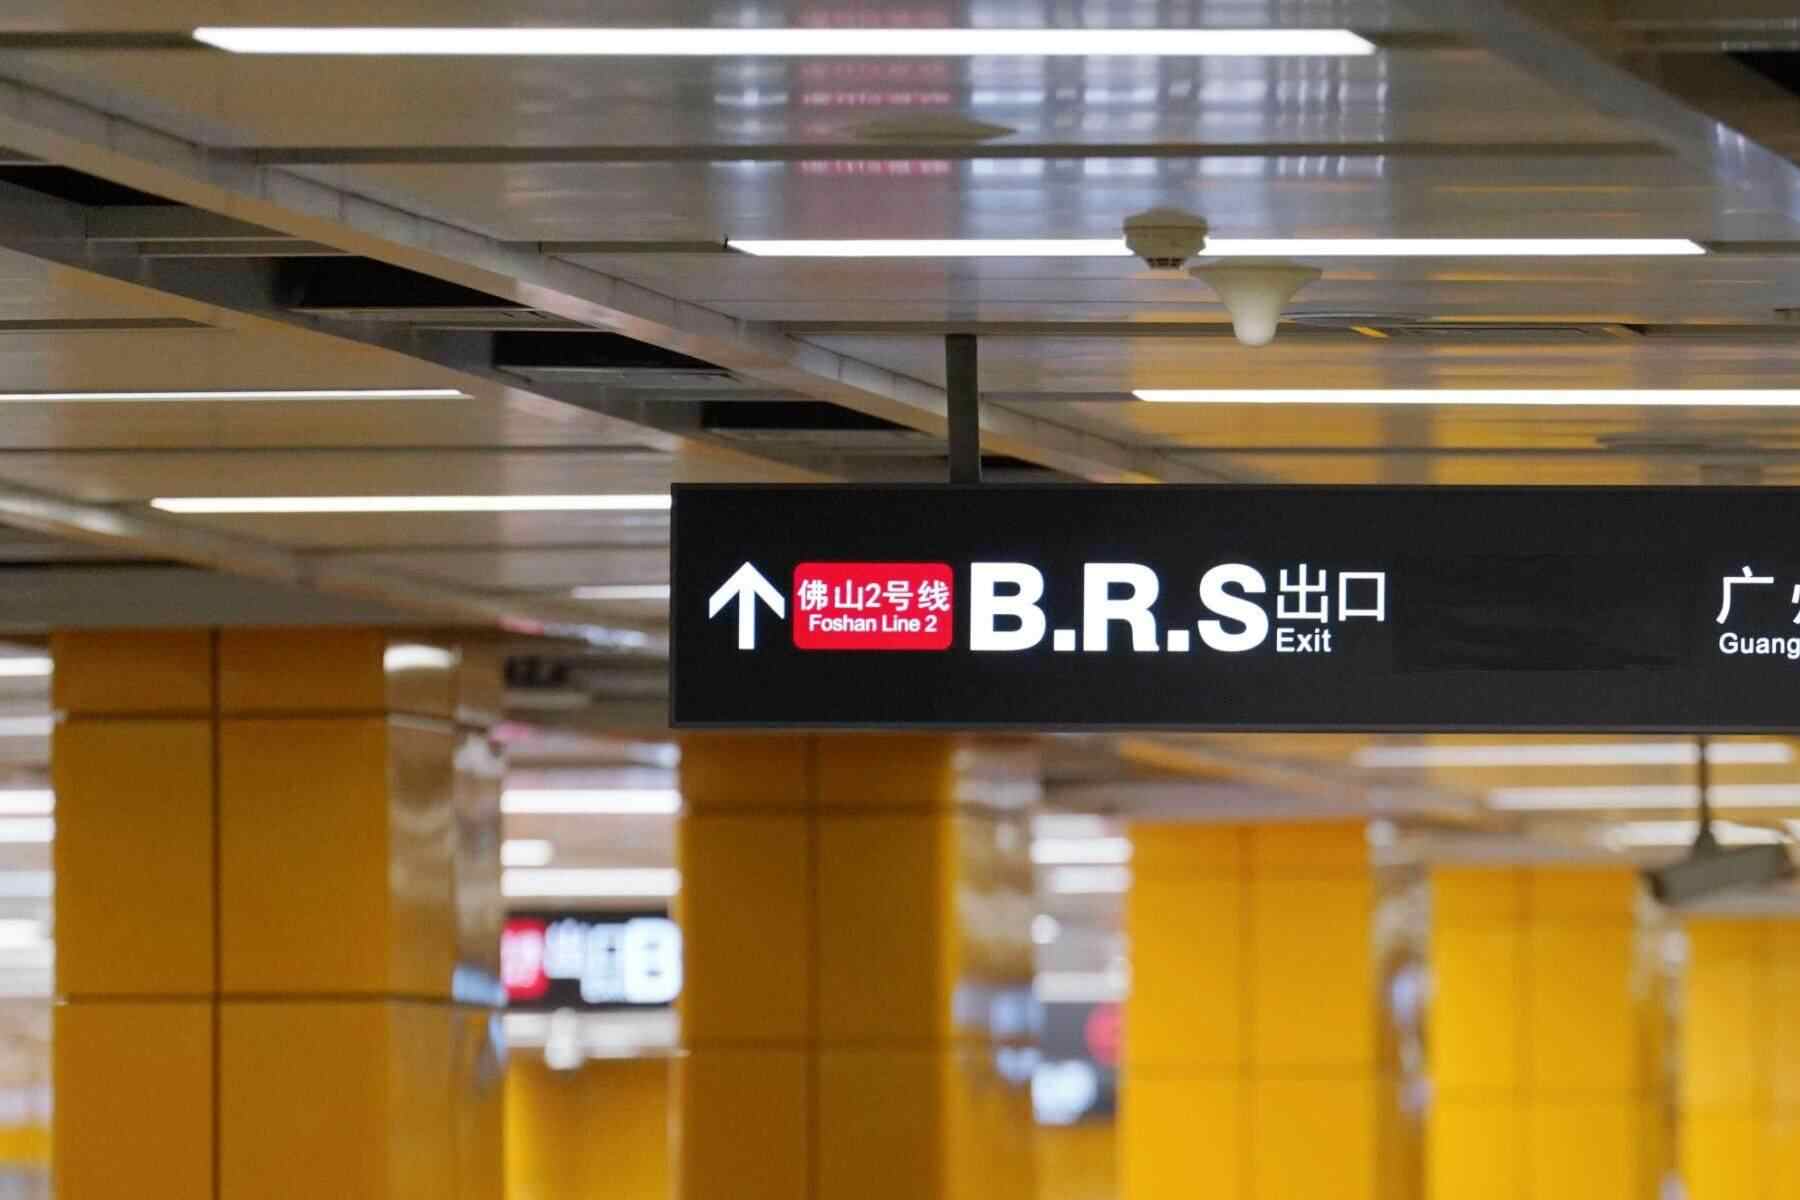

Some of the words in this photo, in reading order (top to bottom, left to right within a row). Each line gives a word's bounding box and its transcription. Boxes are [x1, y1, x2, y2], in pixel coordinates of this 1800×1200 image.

[797, 579, 951, 612] 佛山2号线
[969, 561, 1270, 653] B.R.S
[1276, 563, 1386, 624] 出口
[808, 613, 878, 633] Foshan
[881, 613, 921, 633] Line
[924, 613, 938, 633] 2
[1275, 627, 1332, 653] Exit
